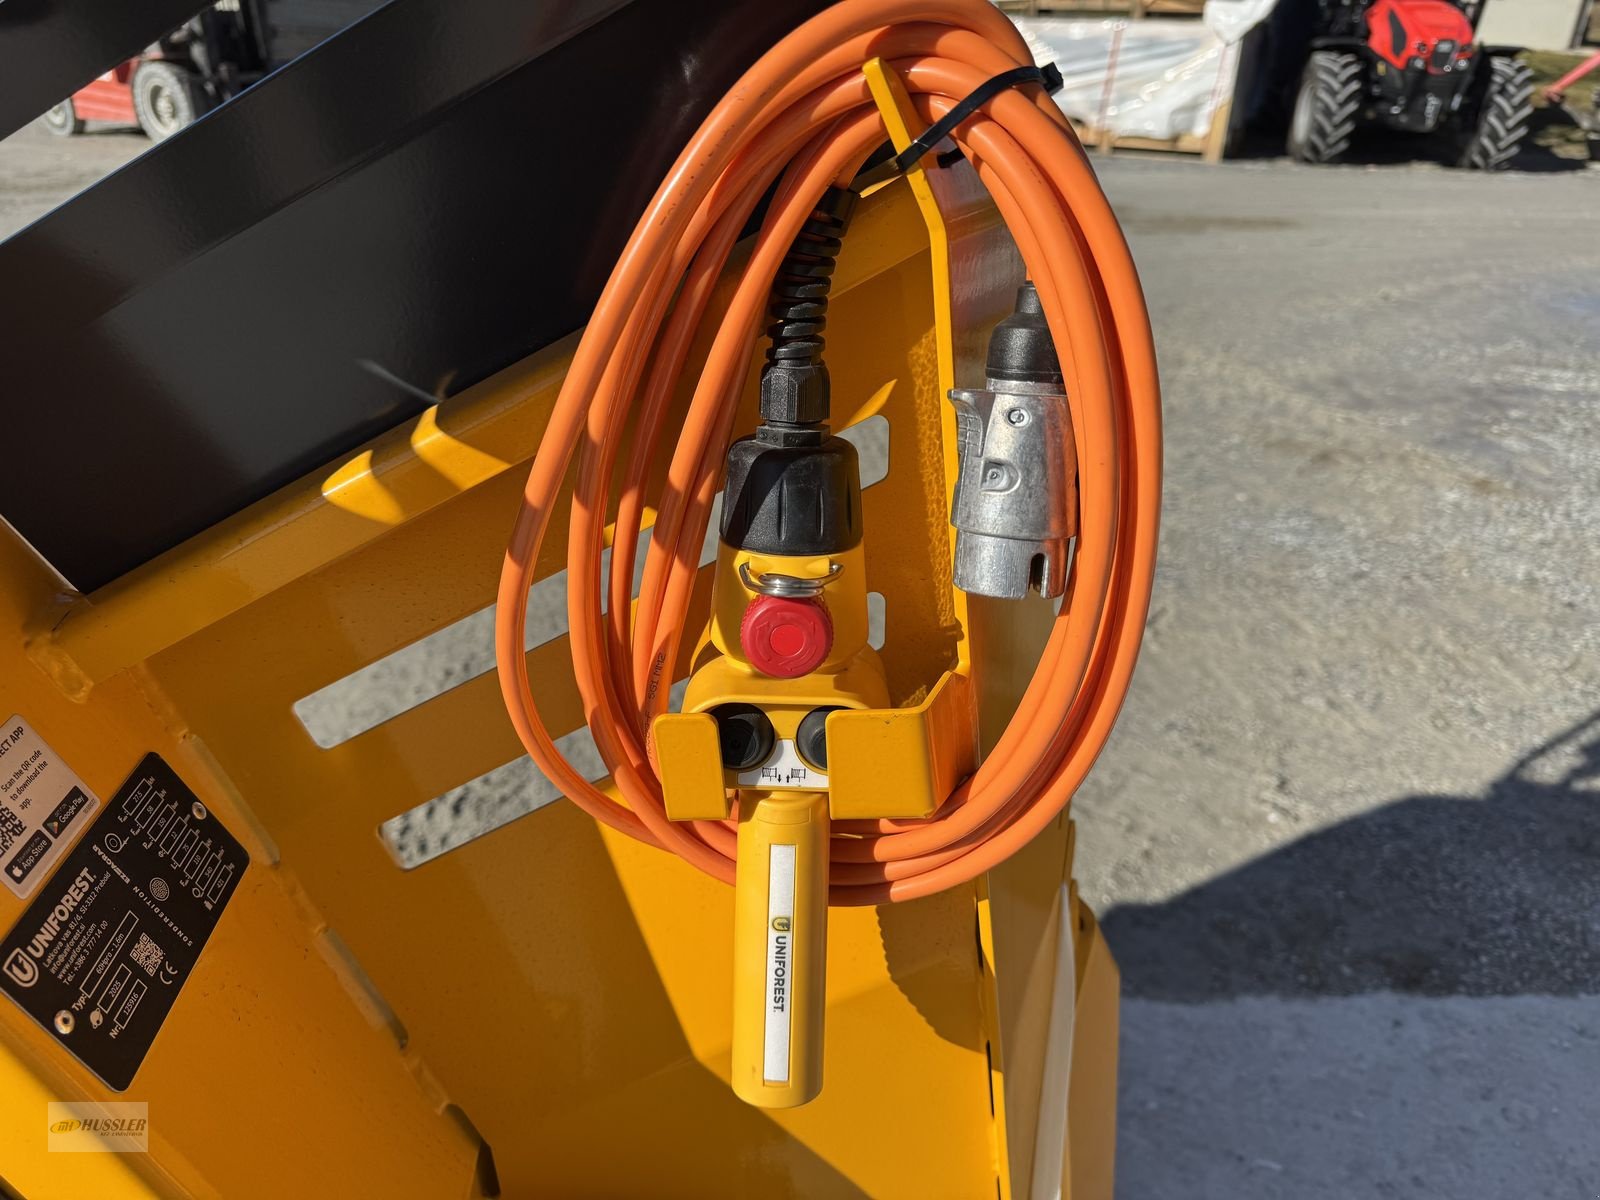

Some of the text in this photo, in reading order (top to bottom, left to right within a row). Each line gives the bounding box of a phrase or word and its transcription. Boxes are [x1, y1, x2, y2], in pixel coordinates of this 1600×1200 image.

[0, 726, 24, 759] ECT APP
[0, 749, 42, 792] Scan the QR code
[16, 768, 40, 794] download
[36, 760, 48, 770] the
[18, 797, 32, 810] app.
[59, 795, 84, 823] Google Play
[170, 831, 178, 839] 12
[182, 844, 189, 852] 75
[20, 839, 47, 869] App Store
[204, 867, 213, 877] 540
[42, 941, 63, 967] Latkova
[61, 929, 71, 941] vas
[94, 870, 110, 892] Prebold
[133, 886, 193, 946] SONDEREDITION
[50, 922, 86, 973] info@uniforest.si
[57, 922, 96, 980] www.uniforest.com
[74, 954, 86, 971] +386
[87, 937, 99, 950] 777
[95, 929, 103, 939] 14
[100, 920, 108, 930] 00
[72, 994, 87, 1011] Typ:
[96, 952, 112, 974] 60Hpro
[108, 981, 121, 998] 2025
[123, 992, 139, 1015] 125916
